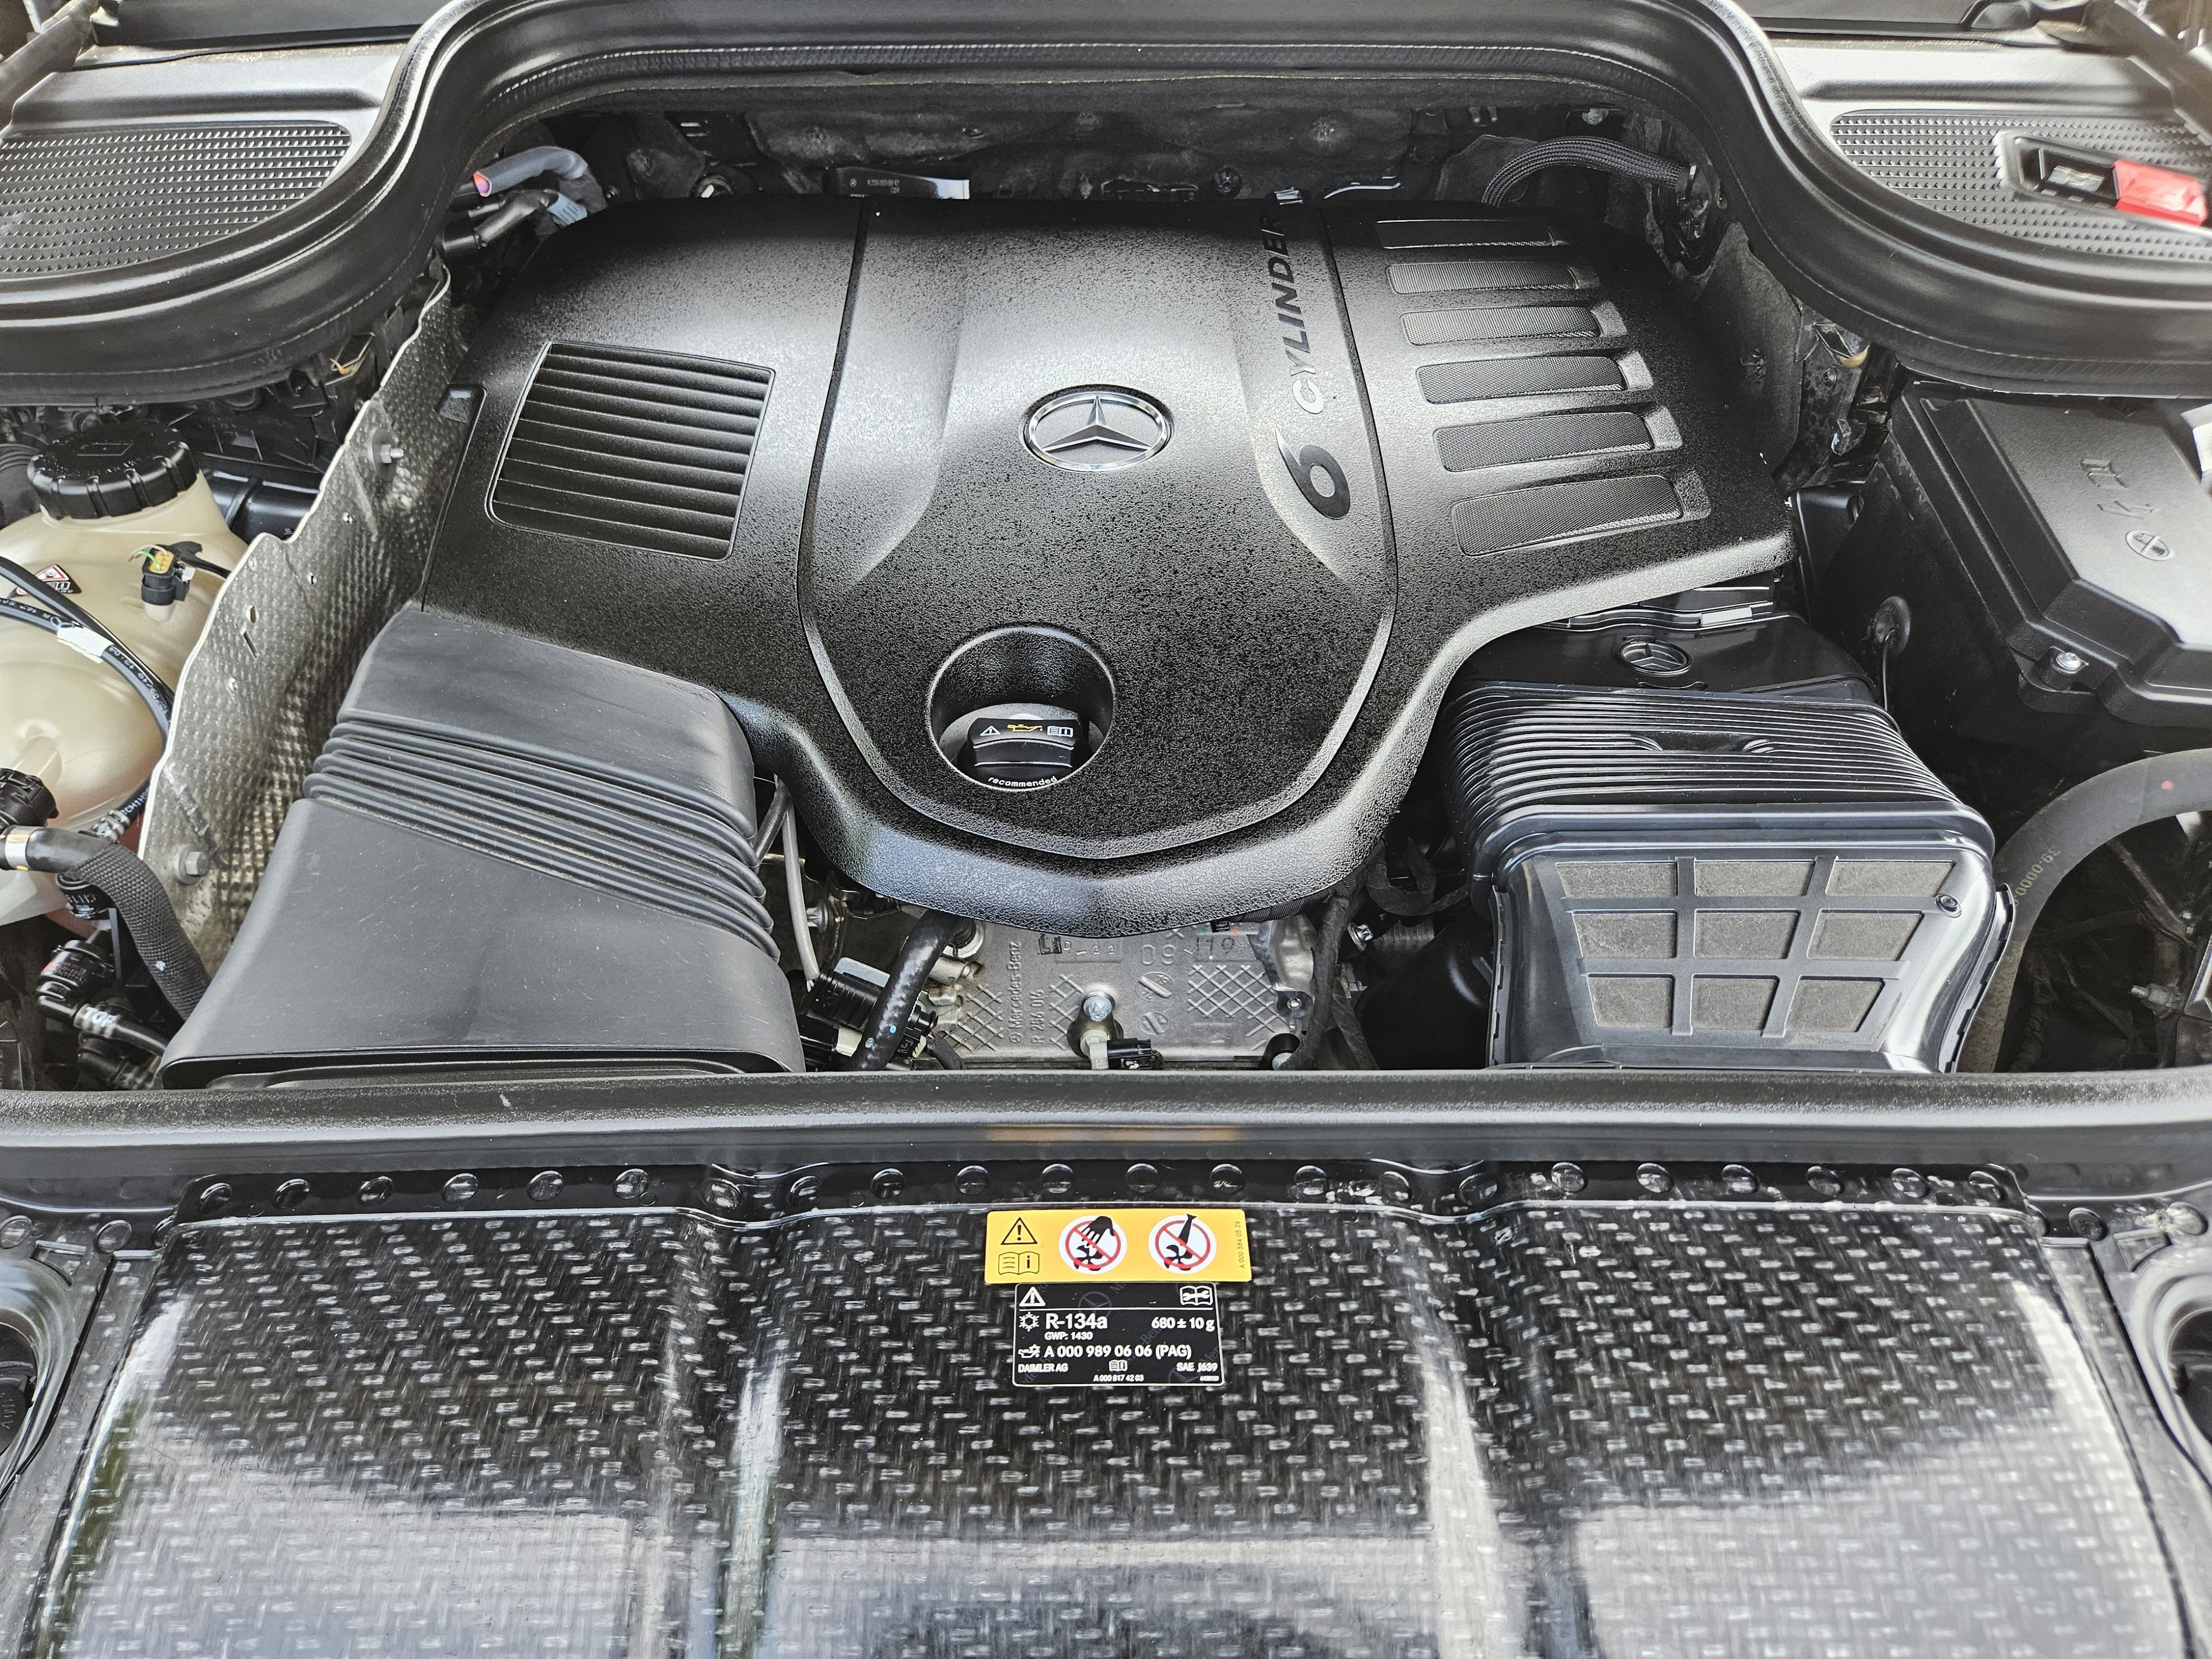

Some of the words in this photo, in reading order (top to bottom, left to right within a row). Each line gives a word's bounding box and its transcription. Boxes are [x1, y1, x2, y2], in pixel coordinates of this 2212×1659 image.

[1275, 429, 1350, 519] 6
[988, 776, 1057, 788] recommended
[1006, 941, 1022, 1029] Mercedes-Benz
[1030, 1035, 1045, 1044] R
[1045, 1312, 1108, 1329] R-134a
[1151, 1317, 1176, 1329] 680
[1189, 1317, 1204, 1329] 10
[1206, 1319, 1215, 1332] g
[1044, 1331, 1069, 1340] GWP:
[1070, 1331, 1094, 1340] 1430
[1044, 1345, 1055, 1358] A
[1057, 1344, 1083, 1358] 000
[1086, 1344, 1112, 1357] 989
[1114, 1344, 1133, 1357] 06
[1134, 1344, 1153, 1357] 06
[1155, 1344, 1192, 1360] (PAG)
[1018, 1363, 1055, 1373] DAIMLER
[1055, 1363, 1069, 1372] AG
[1176, 1361, 1196, 1372] SAE
[1196, 1361, 1218, 1373] J639
